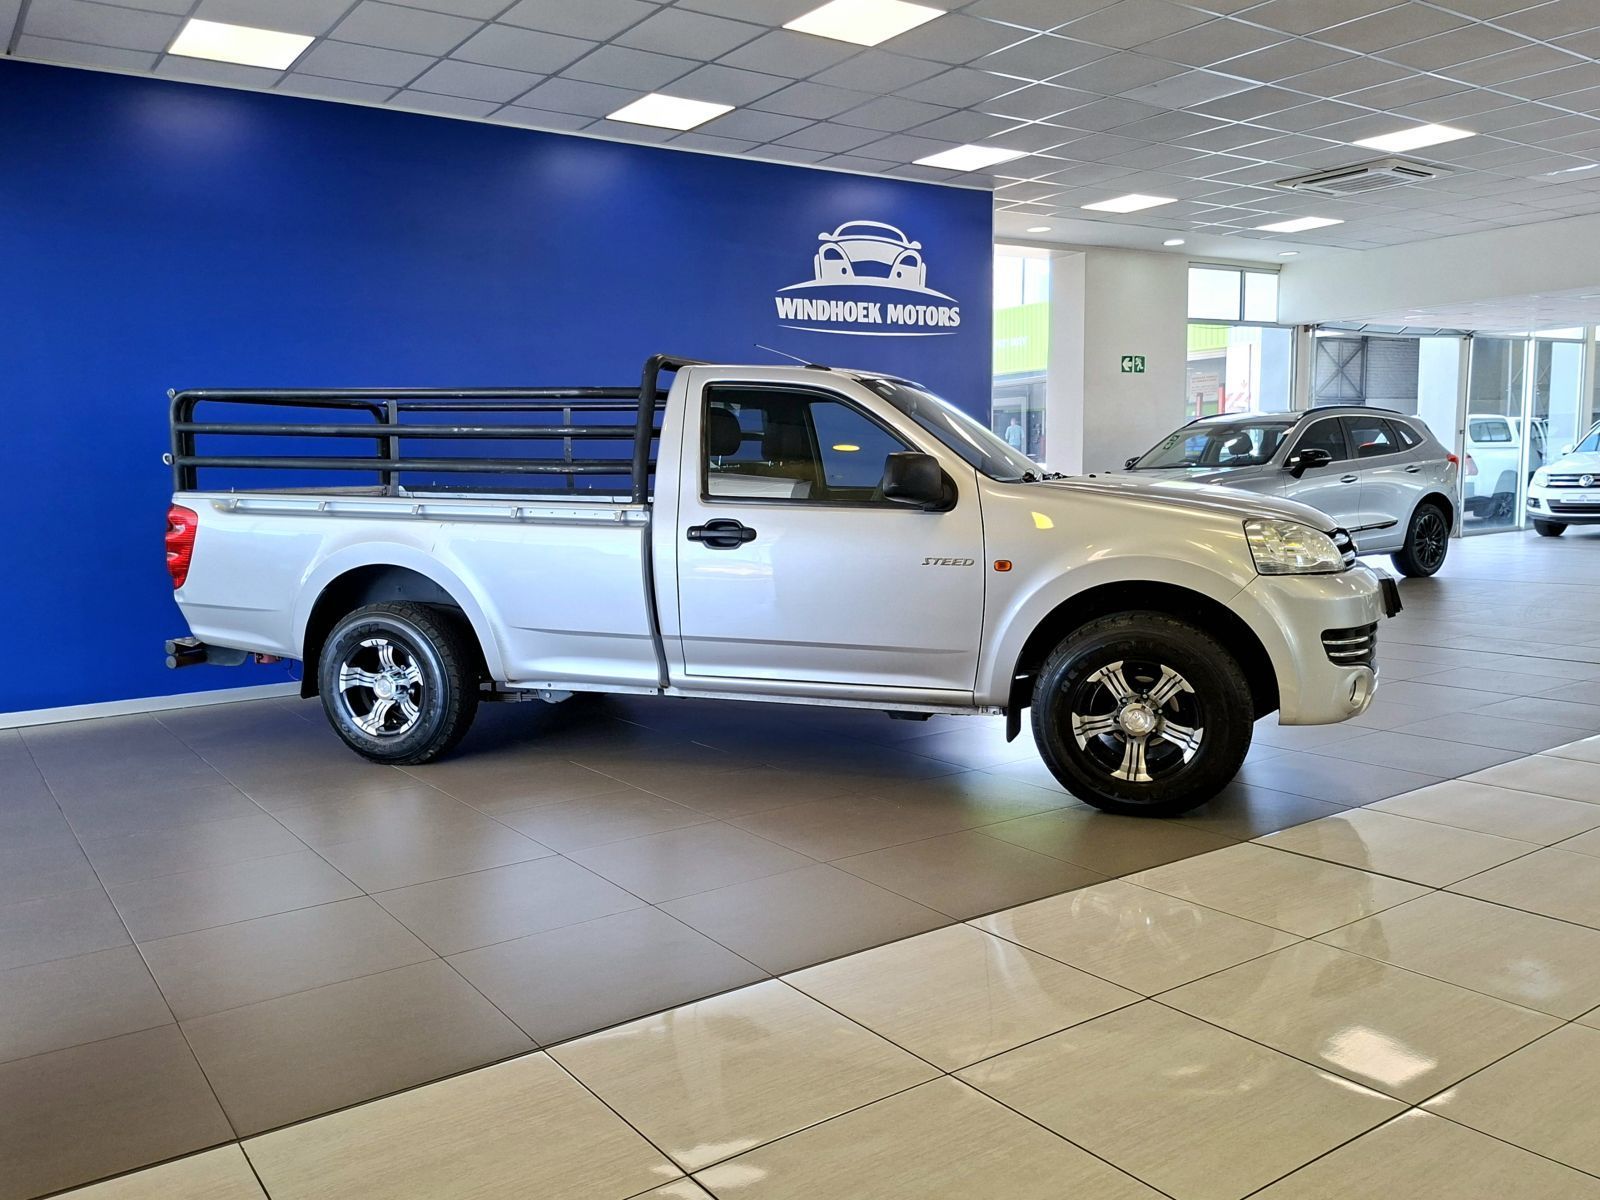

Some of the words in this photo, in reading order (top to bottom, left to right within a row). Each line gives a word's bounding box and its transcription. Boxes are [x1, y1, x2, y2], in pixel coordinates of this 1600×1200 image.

[775, 297, 882, 324] WINDHOEK
[887, 303, 961, 327] MOTORS
[922, 557, 975, 567] STEED
